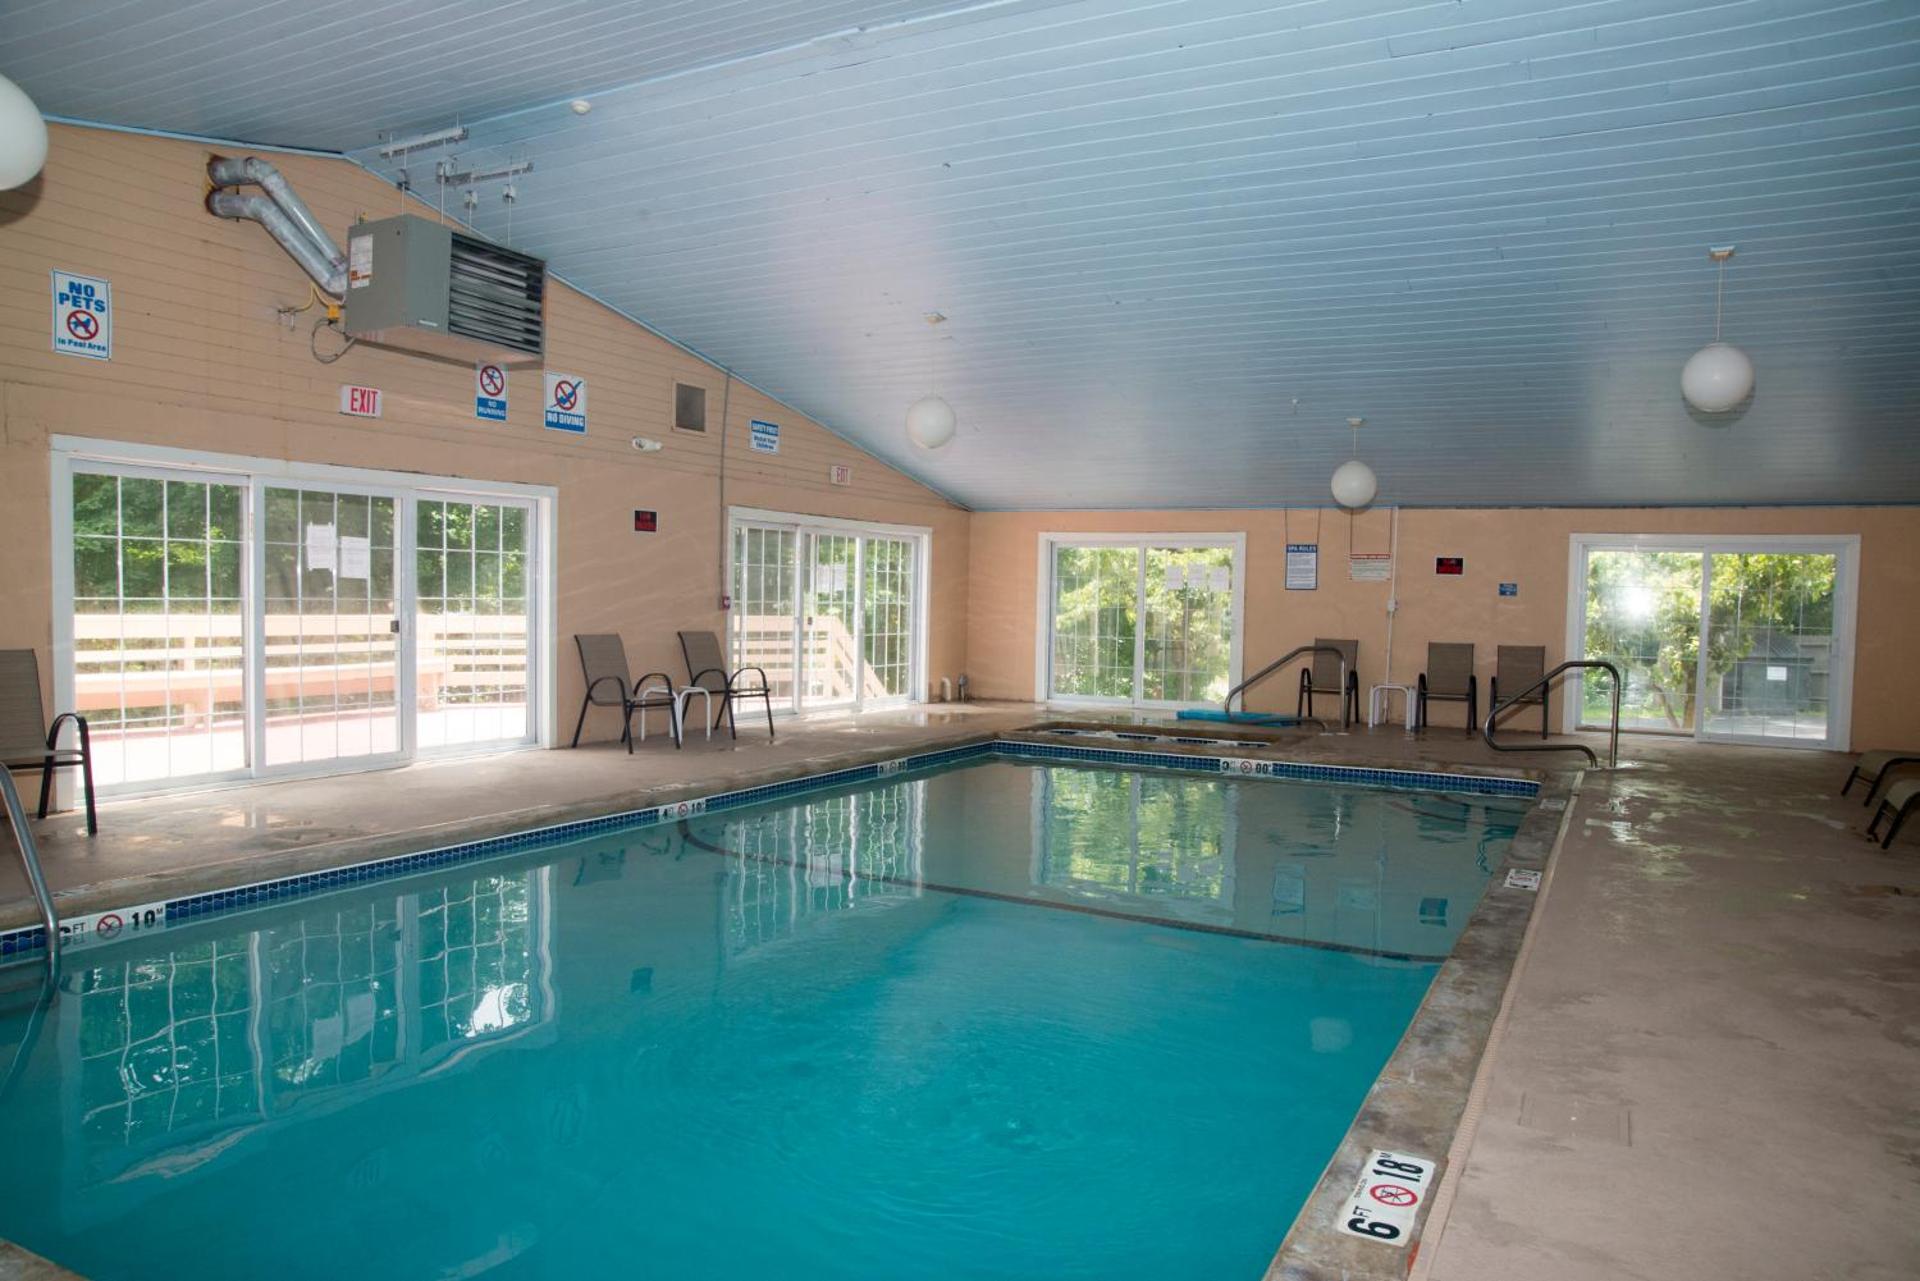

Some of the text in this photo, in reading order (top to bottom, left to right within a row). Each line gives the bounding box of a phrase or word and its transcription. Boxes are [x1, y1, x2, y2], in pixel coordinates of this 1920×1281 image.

[68, 281, 95, 298] NO
[58, 291, 106, 313] PETS
[58, 337, 67, 345] In
[87, 342, 107, 352] Area
[350, 387, 378, 414] EXIT
[488, 400, 498, 409] NO
[478, 406, 505, 418] RUNNING
[547, 412, 584, 427] NO DIVING
